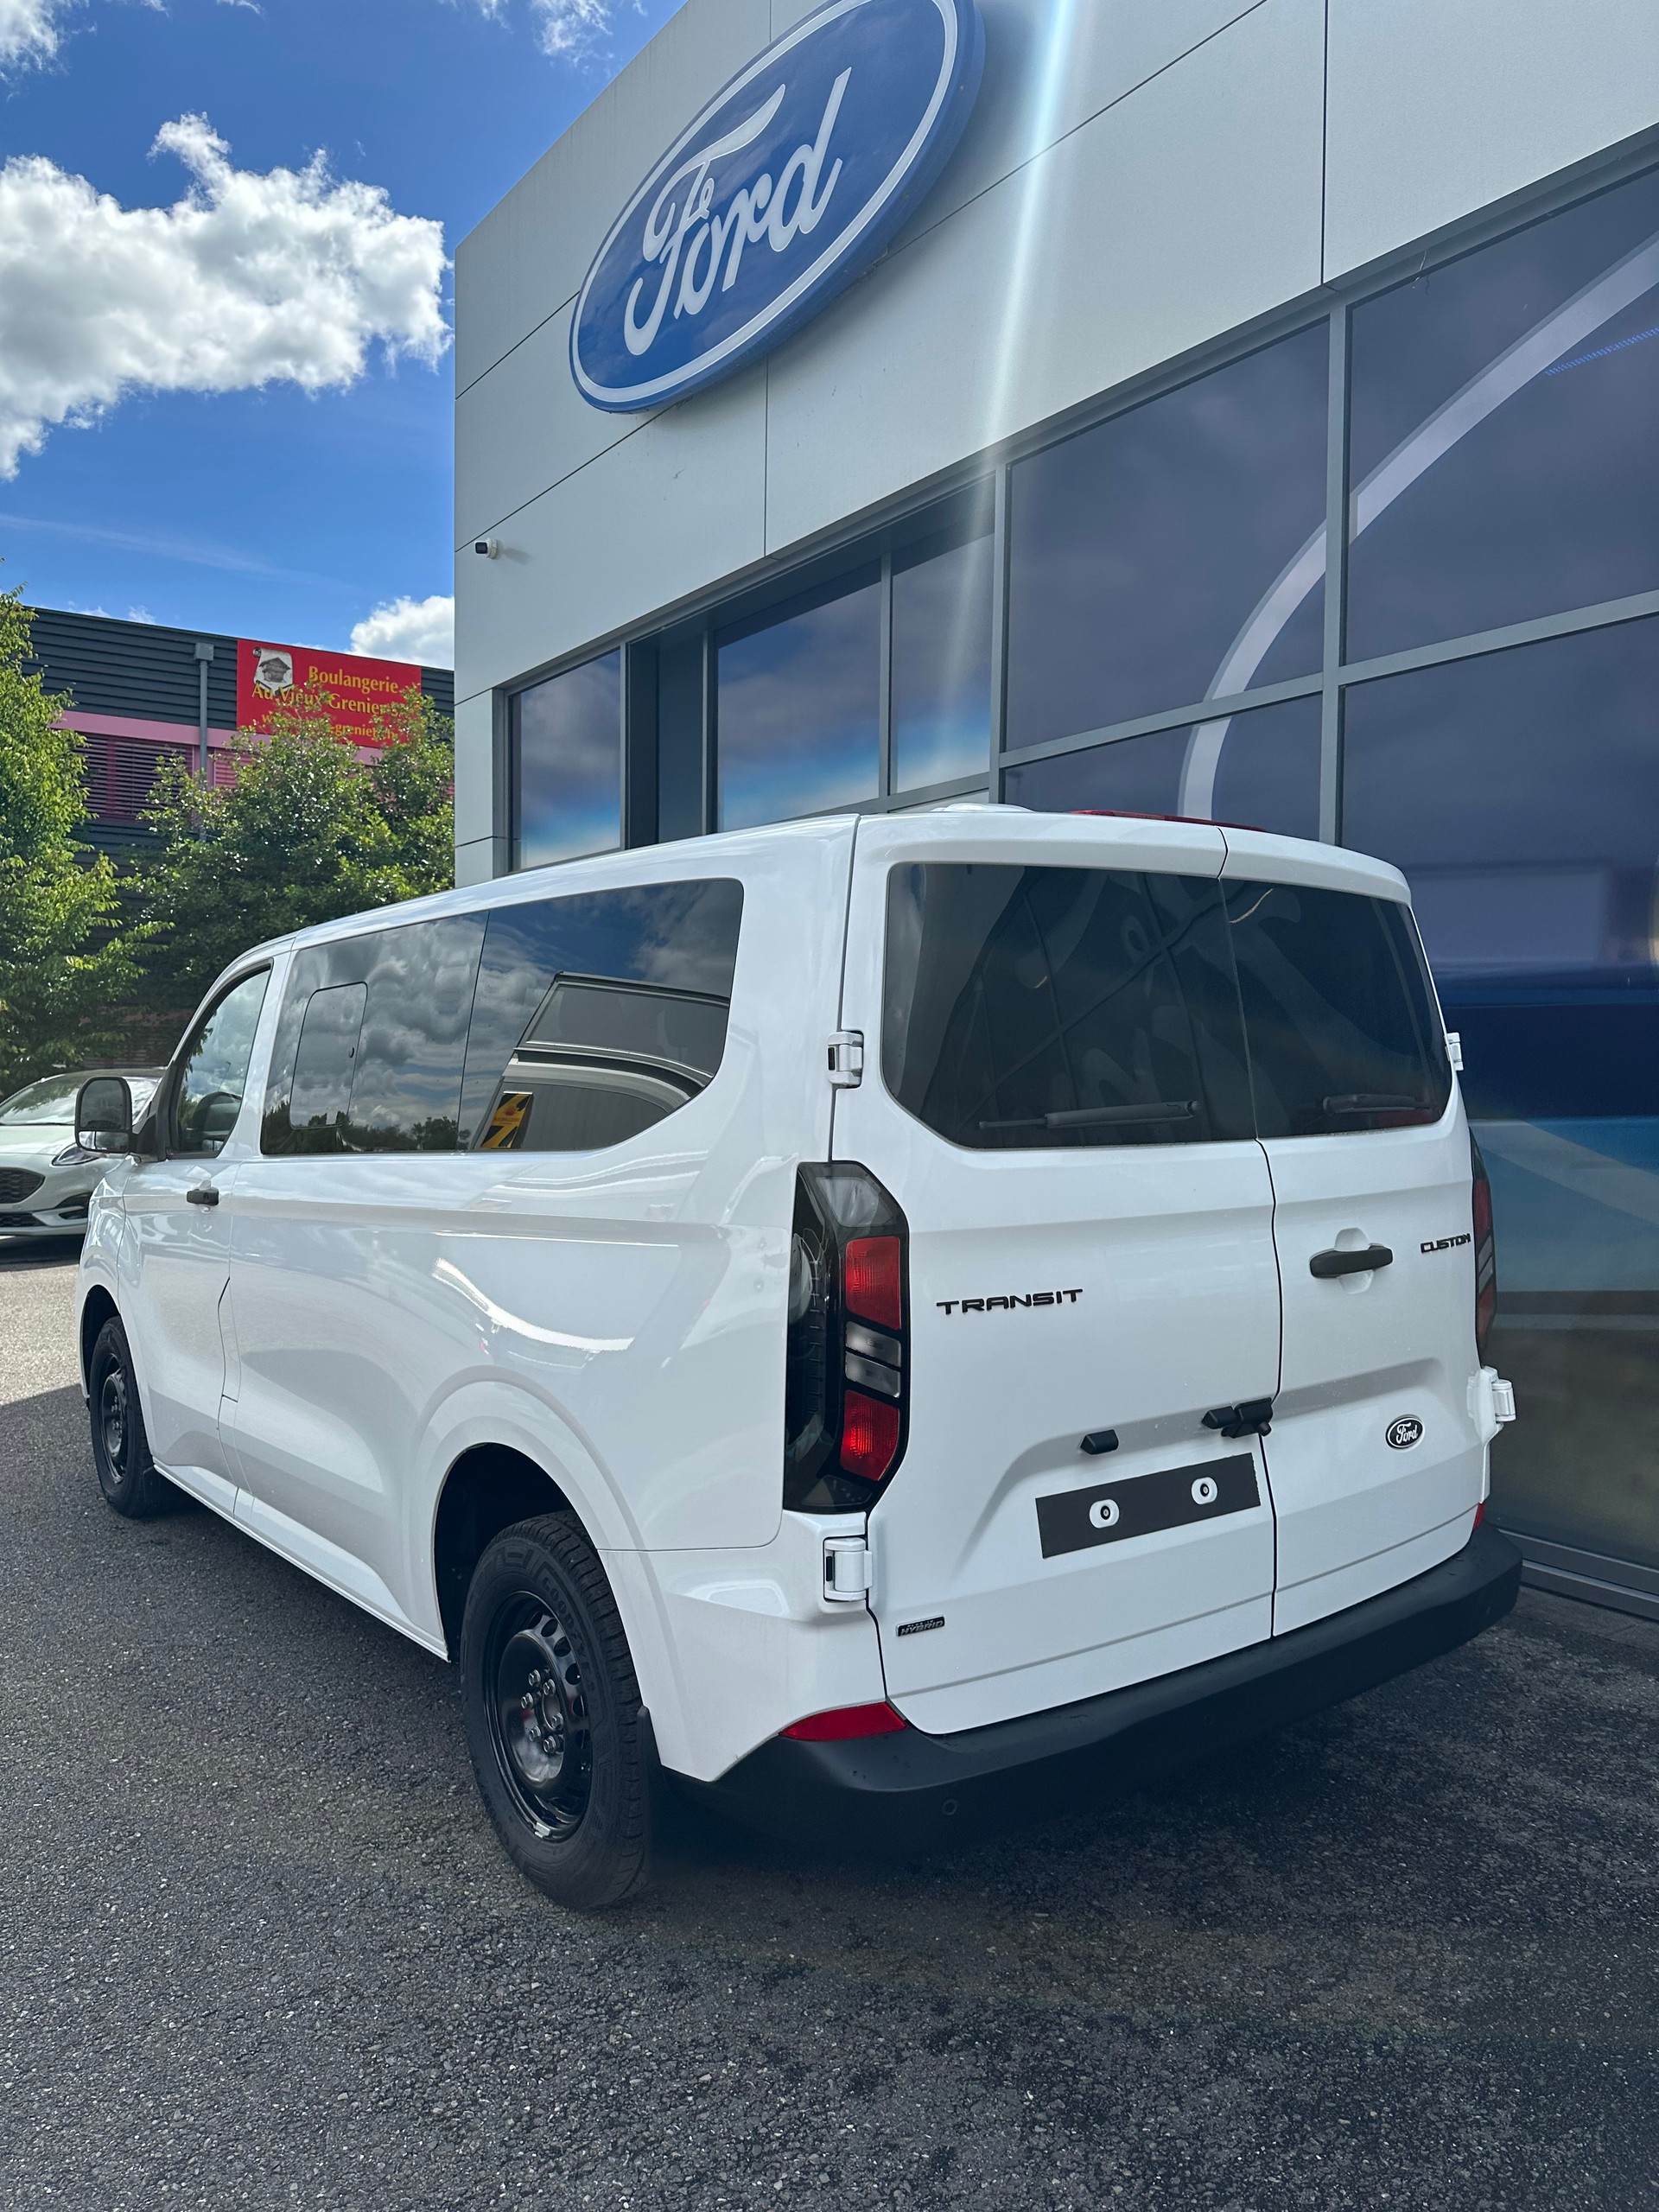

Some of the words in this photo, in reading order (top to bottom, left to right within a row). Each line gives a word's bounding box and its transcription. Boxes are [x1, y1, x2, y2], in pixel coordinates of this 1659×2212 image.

[624, 67, 851, 356] Ford
[308, 665, 399, 694] Boulangerie
[251, 683, 273, 700] Au
[278, 684, 322, 706] Vieux
[1420, 1233, 1471, 1254] CUSTOM
[936, 1288, 1084, 1315] TRANSIT
[1395, 1421, 1419, 1444] Ford
[900, 1620, 944, 1635] HYBRID
[541, 1575, 600, 1713] GOODYEA
